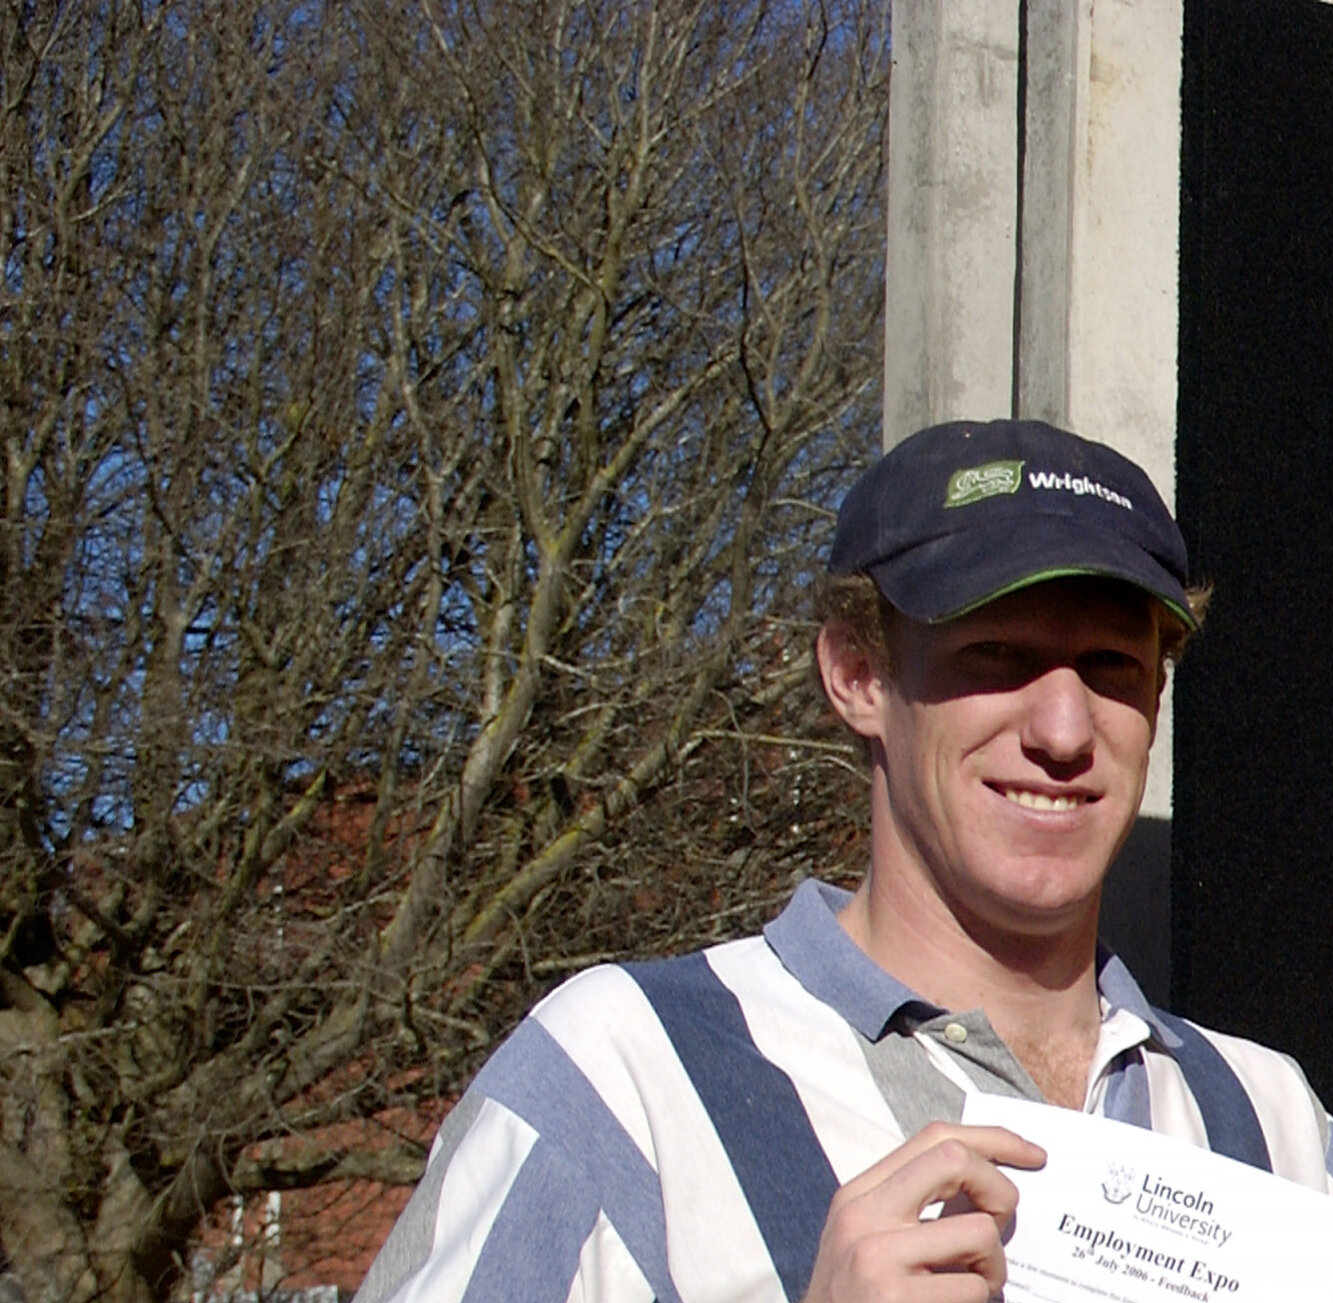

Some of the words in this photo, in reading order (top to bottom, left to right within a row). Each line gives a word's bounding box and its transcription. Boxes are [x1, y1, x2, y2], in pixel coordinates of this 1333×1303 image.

[1142, 1173, 1214, 1215] Lincoln
[1135, 1193, 1233, 1248] University
[1057, 1213, 1185, 1275] Employment
[1188, 1259, 1240, 1293] Expo
[1095, 1253, 1120, 1274] July
[1121, 1263, 1148, 1282] 2006
[1157, 1275, 1209, 1303] Feedback
